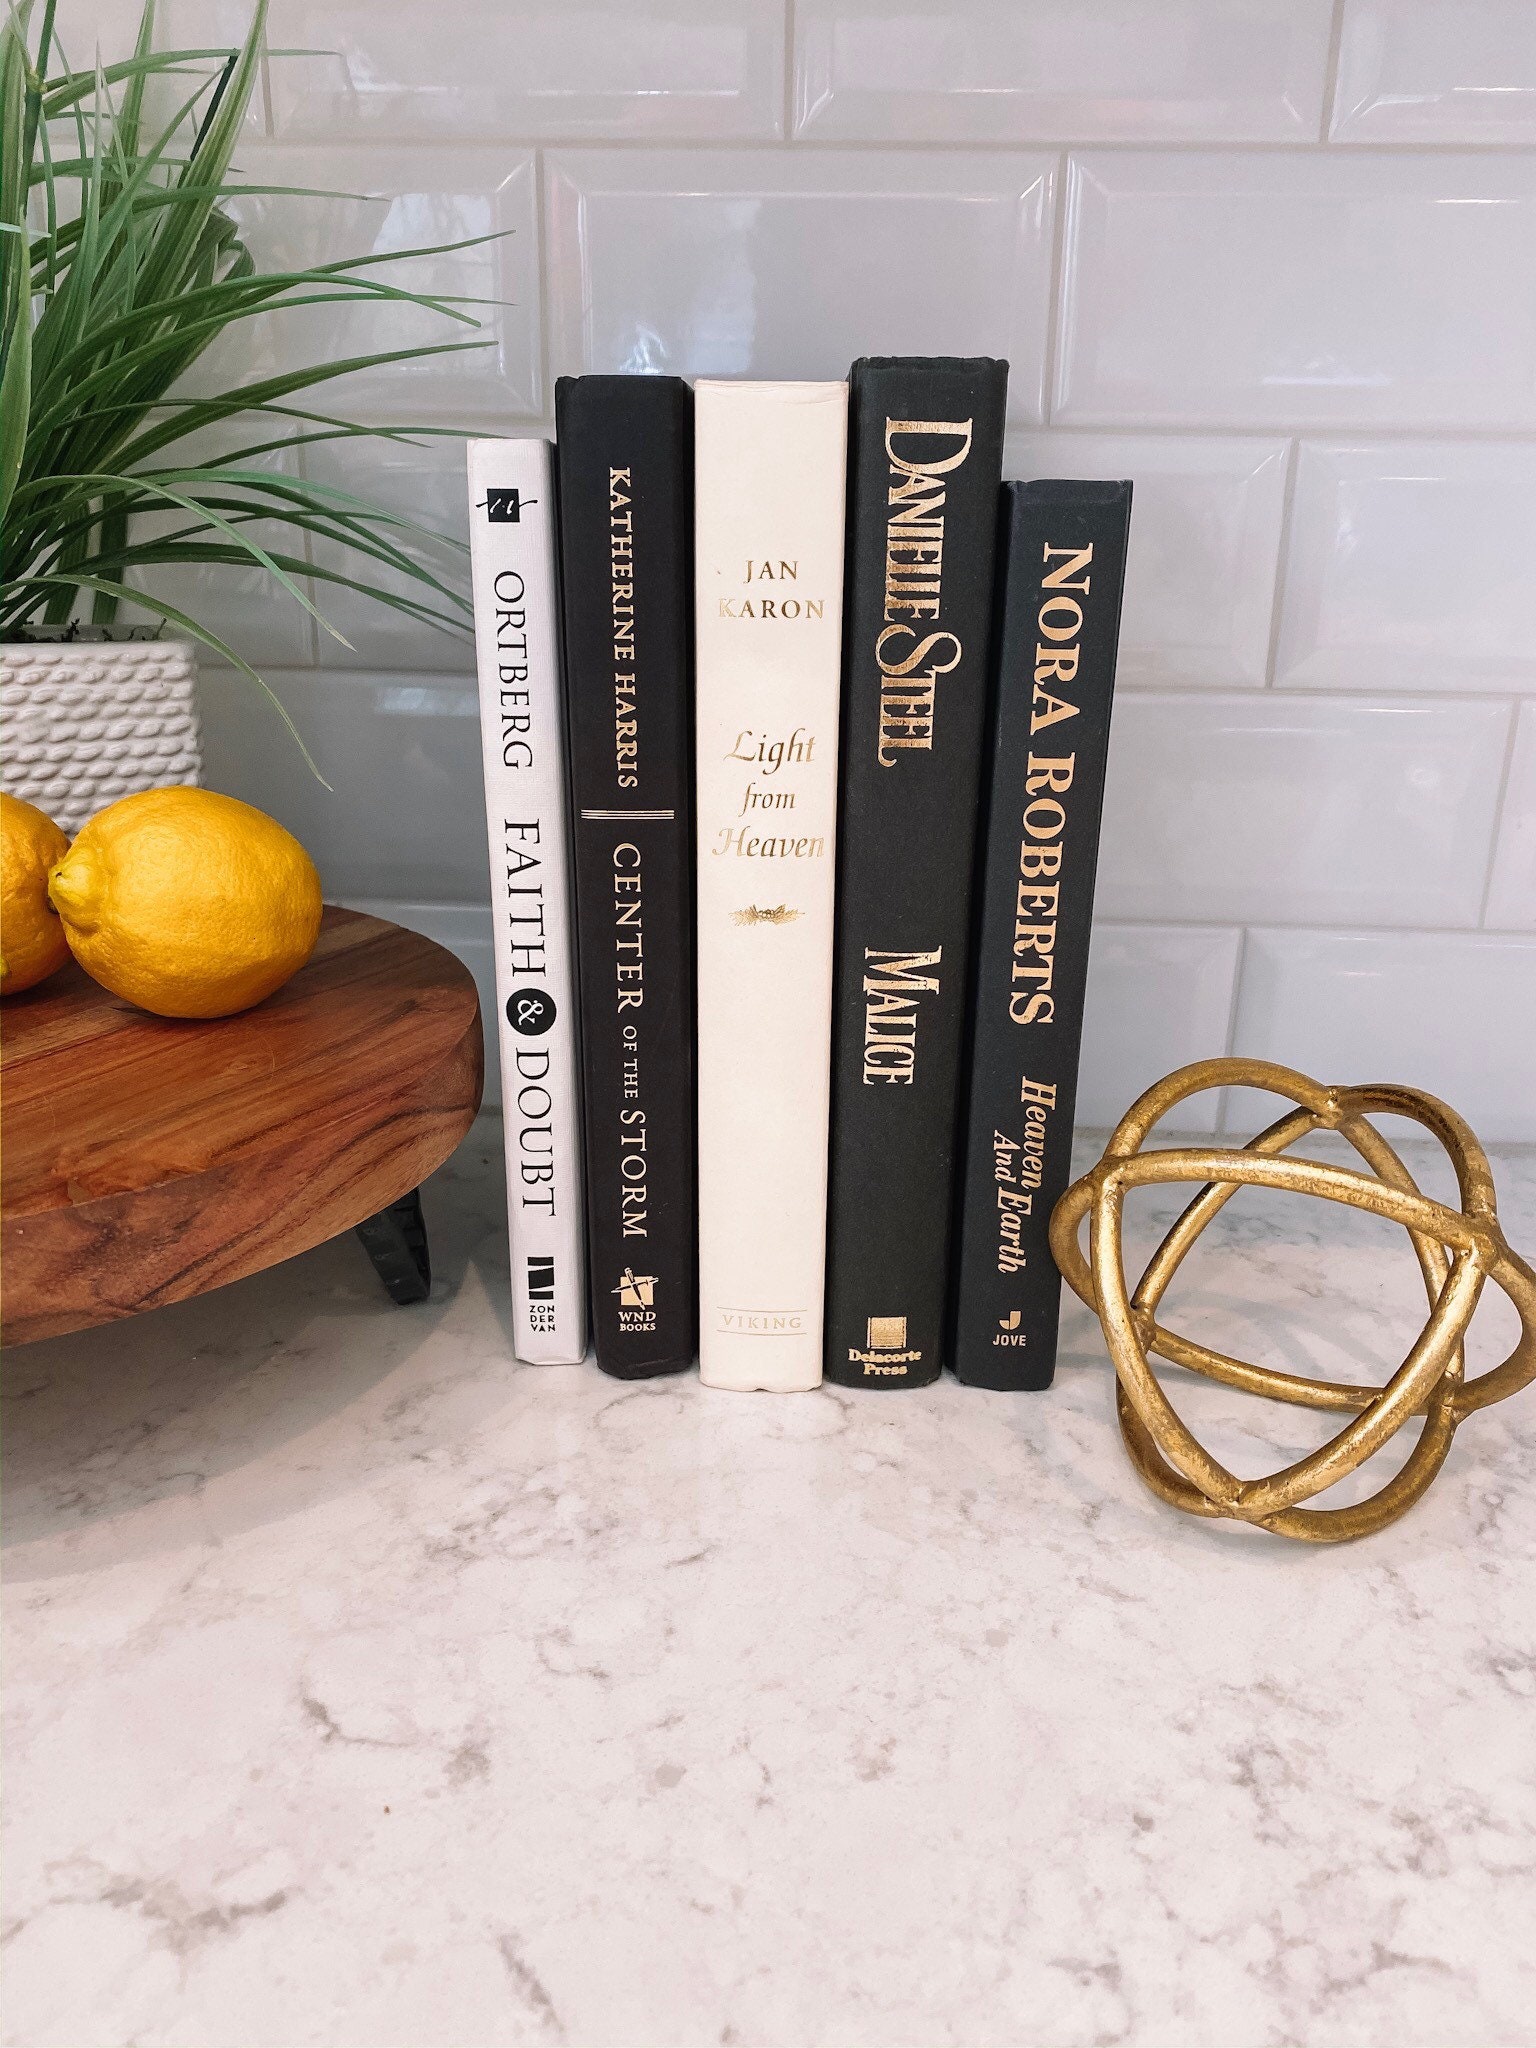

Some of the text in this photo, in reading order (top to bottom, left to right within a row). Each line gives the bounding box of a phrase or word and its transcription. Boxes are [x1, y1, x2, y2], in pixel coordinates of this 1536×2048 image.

[744, 560, 798, 584] JAN
[874, 416, 973, 767] DANIELLE STEEL
[718, 599, 825, 619] KARON
[609, 466, 638, 789] KATHERINE HARRIS
[494, 570, 534, 771] ORTBERG
[723, 728, 816, 776] Light
[739, 782, 797, 817] from
[1008, 541, 1094, 1025] NORA ROBERTS
[712, 827, 825, 859] Heaven
[504, 818, 546, 978] FAITH
[862, 945, 943, 1086] MALICE
[613, 842, 648, 1239] CENTER OF THE STORM
[515, 1046, 557, 1217] DOUBT
[1019, 1076, 1058, 1189] Heaven
[993, 1130, 1033, 1273] And Earth
[529, 1305, 555, 1313] ZON
[530, 1315, 555, 1323] DER
[618, 1311, 656, 1322] WND
[722, 1314, 802, 1329] VIKING
[531, 1324, 556, 1332] VAN
[619, 1324, 656, 1332] BOOKS
[992, 1333, 1027, 1347] JOVE
[848, 1348, 922, 1364] Delacorte
[863, 1363, 907, 1376] Press
